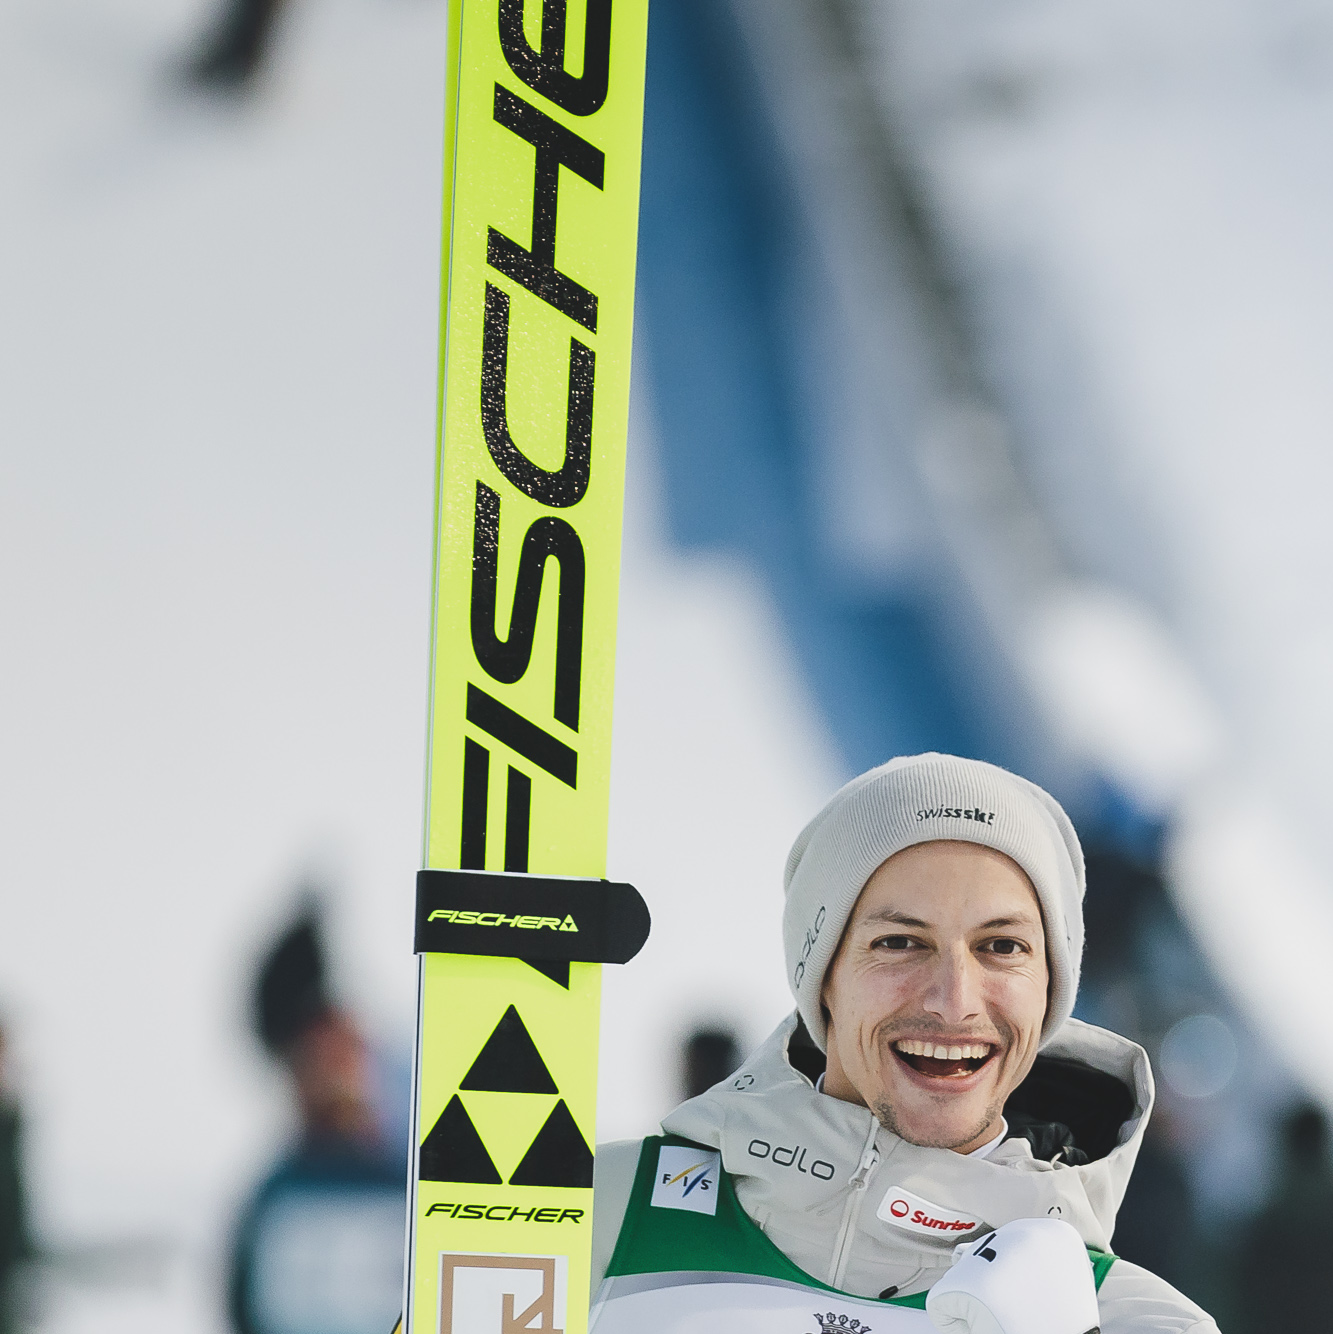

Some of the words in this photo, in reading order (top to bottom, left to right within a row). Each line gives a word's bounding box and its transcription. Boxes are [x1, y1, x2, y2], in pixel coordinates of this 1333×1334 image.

[427, 909, 562, 931] FISCHER
[747, 1138, 836, 1181] odlo
[662, 1173, 713, 1192] FIS
[424, 1203, 585, 1224] FISCHER
[910, 1209, 976, 1232] Sunrise
